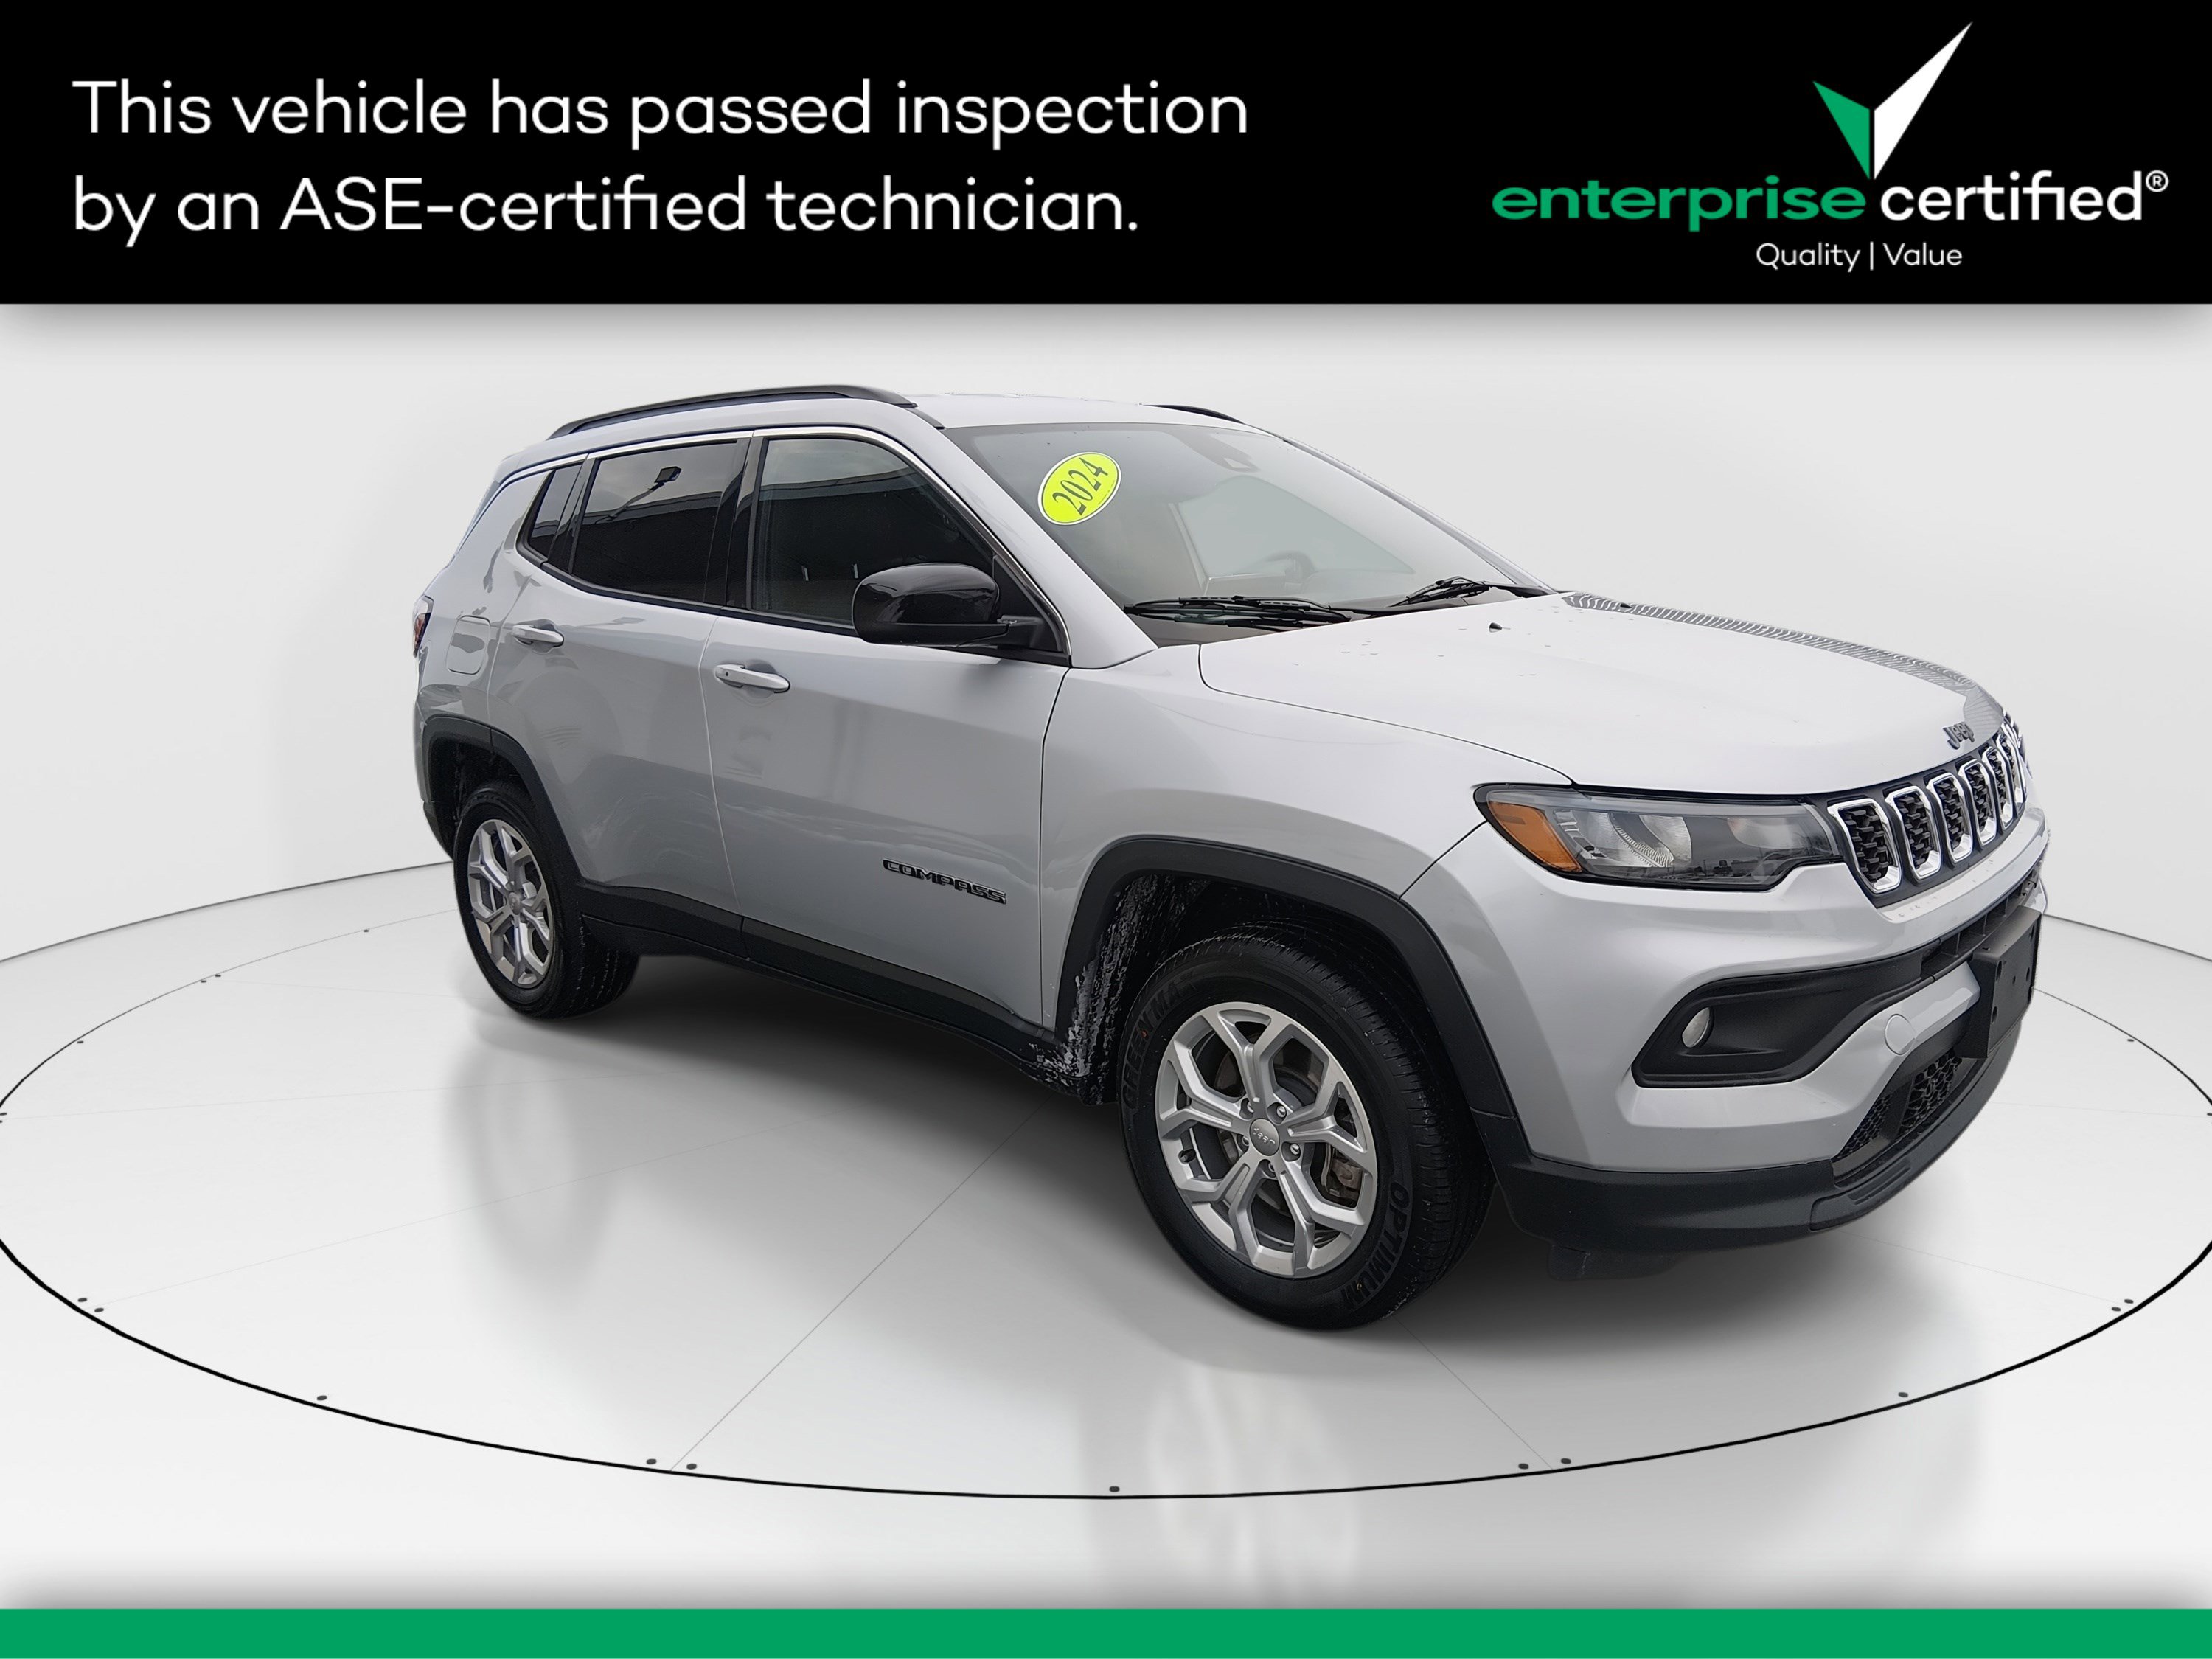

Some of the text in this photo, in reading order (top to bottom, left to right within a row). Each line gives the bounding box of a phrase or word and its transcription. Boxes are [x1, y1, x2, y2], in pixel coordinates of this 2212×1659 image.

[1052, 457, 1108, 515] 2024
[1943, 721, 1975, 750] Jeep
[883, 858, 1007, 905] COMPASS
[1341, 1182, 1410, 1312] OPTIMUM
